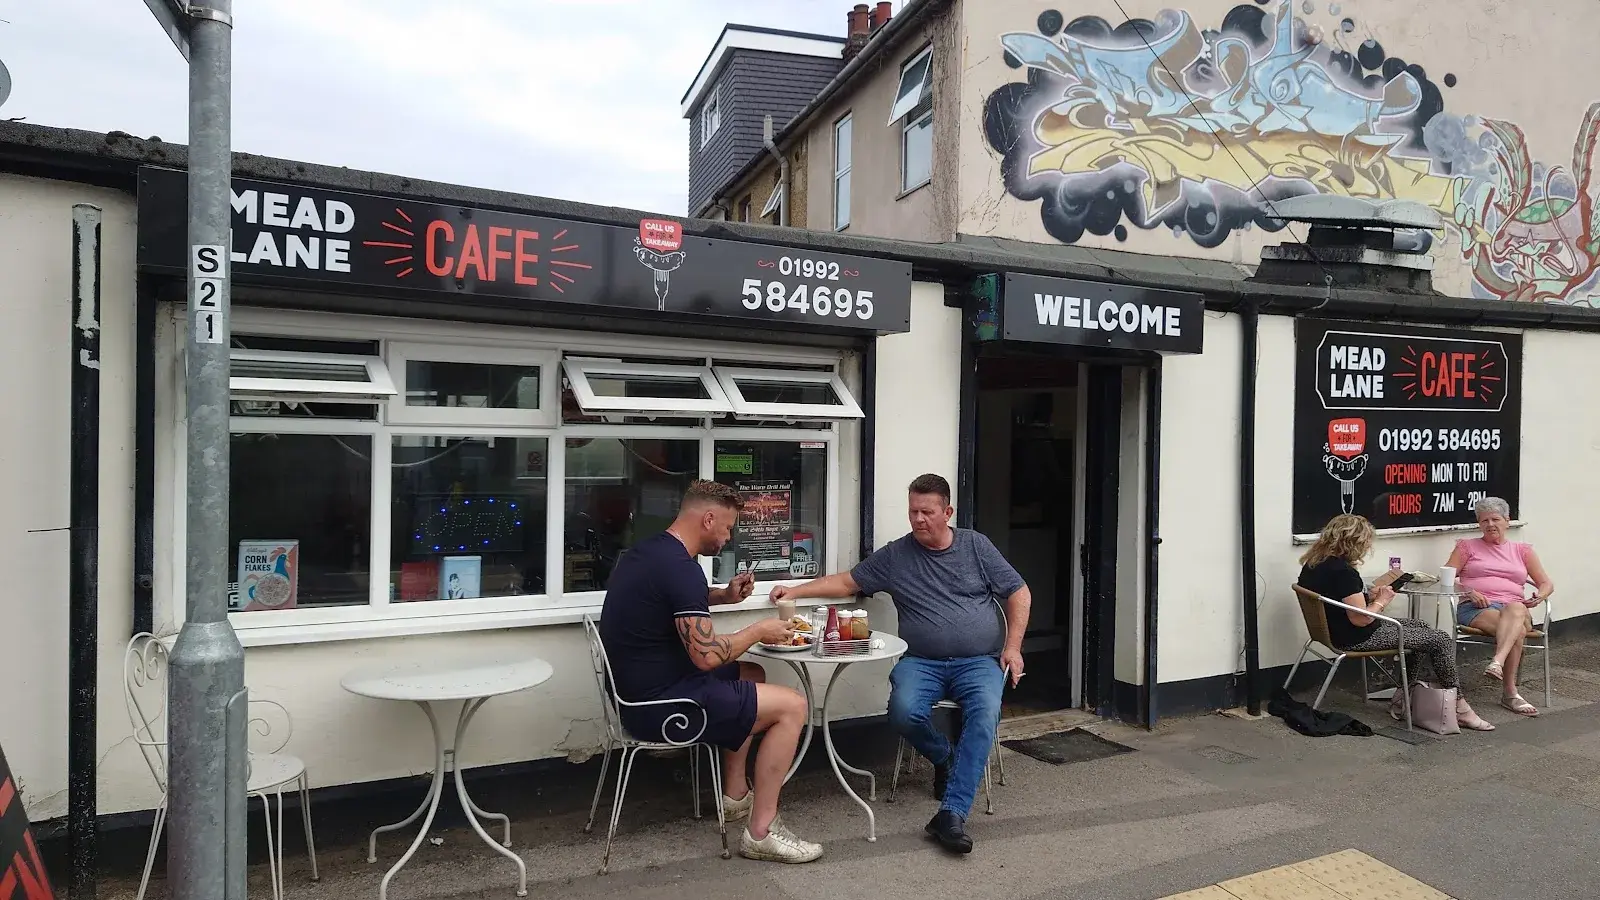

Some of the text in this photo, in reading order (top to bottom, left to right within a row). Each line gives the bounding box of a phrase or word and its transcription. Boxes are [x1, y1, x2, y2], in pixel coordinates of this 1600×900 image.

[230, 188, 355, 233] MEAD
[645, 223, 663, 232] CALL
[230, 228, 351, 273] LANE
[425, 220, 539, 286] CAFE
[645, 238, 678, 248] TAKEAWAY
[778, 256, 840, 281] 01992
[741, 278, 874, 320] 584695
[1034, 293, 1181, 336] WELCOME
[1330, 345, 1386, 371] MEAD
[1421, 351, 1476, 398] CAFE
[1330, 374, 1385, 399] LANE
[1333, 424, 1359, 433] CALL US
[1342, 433, 1352, 442] FOR
[1378, 428, 1501, 451] 01992 584695
[1333, 443, 1363, 451] TAKEAWAY
[1385, 462, 1488, 485] OPENING MON TO FRI
[1389, 493, 1422, 515] HOURS
[1432, 492, 1455, 513] 7AM
[425, 512, 514, 538] OPEN
[245, 555, 267, 564] CORN
[245, 564, 271, 572] FLAKES
[796, 554, 813, 562] FREE
